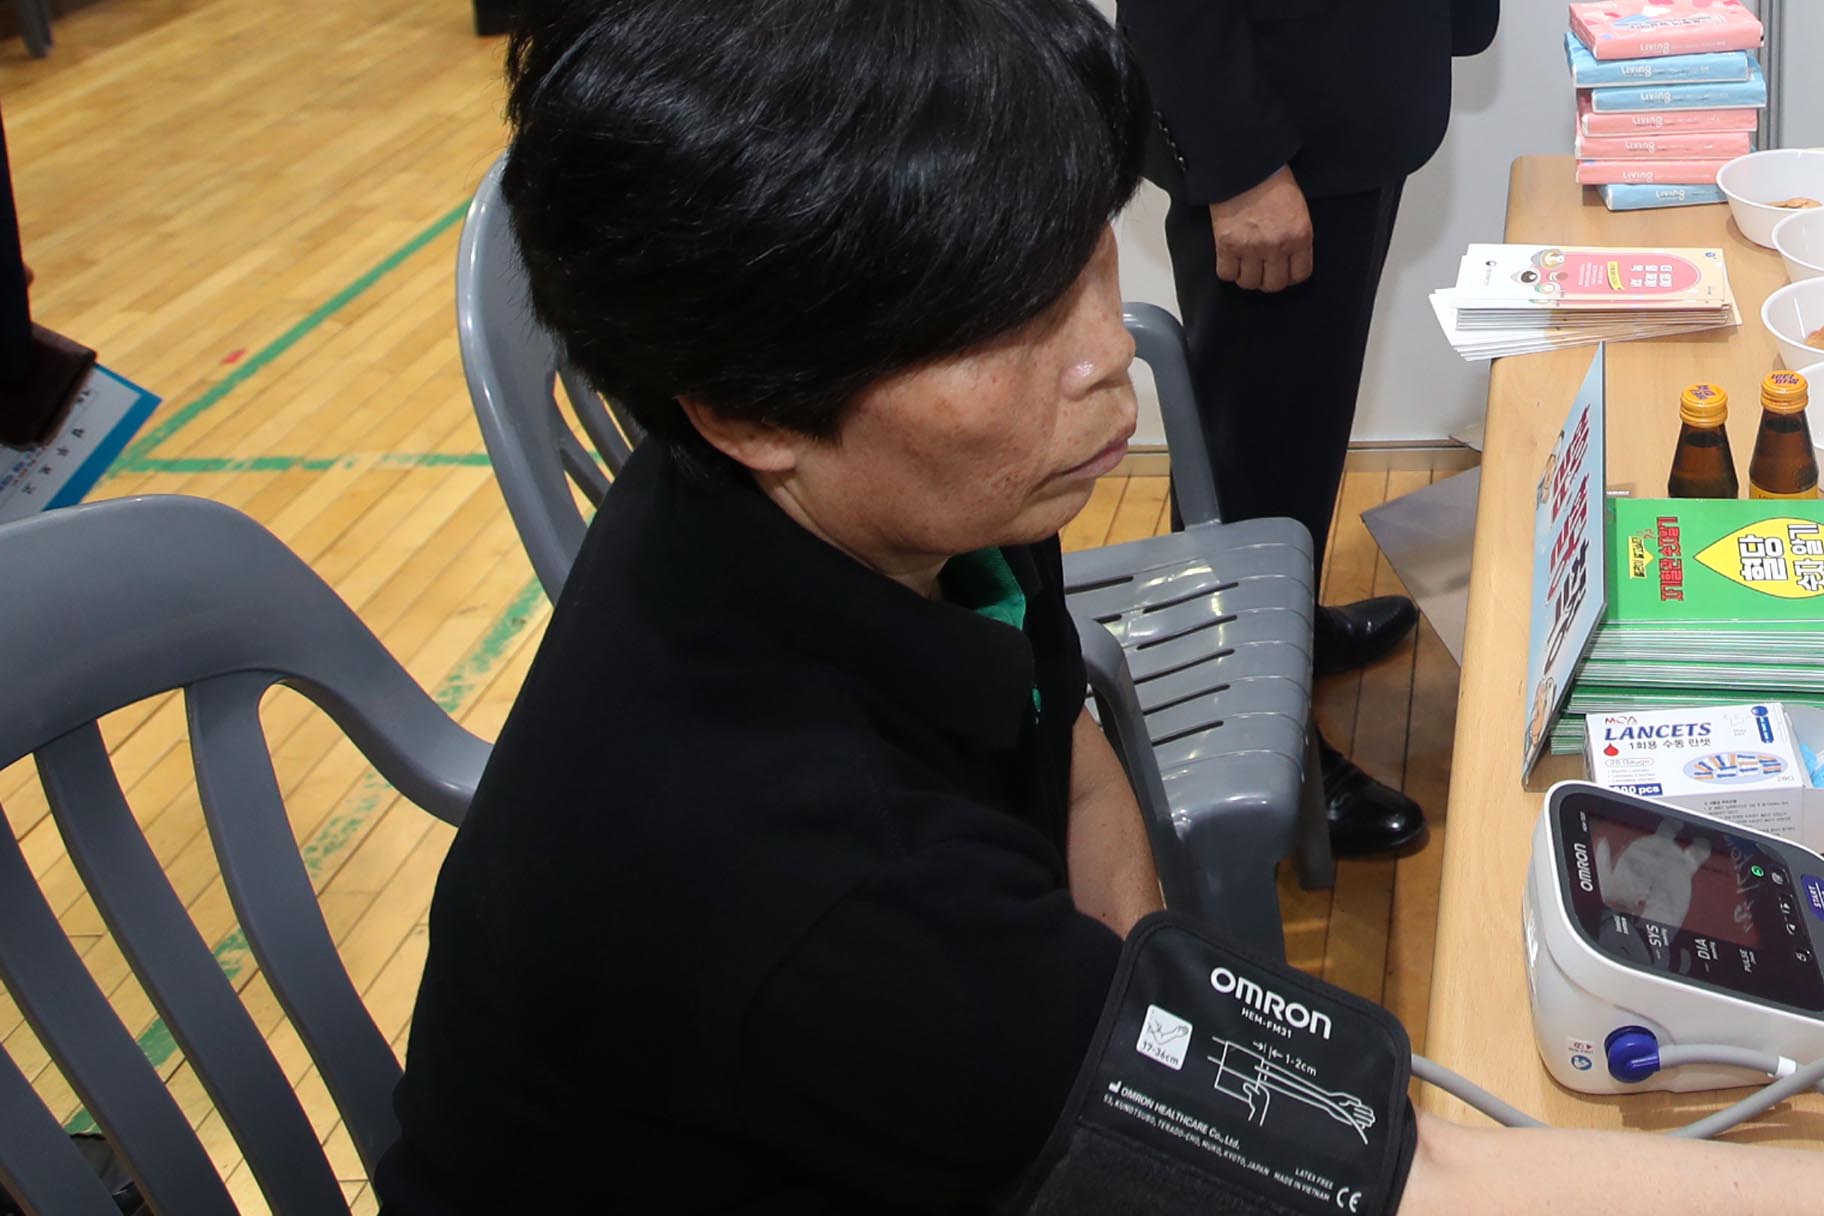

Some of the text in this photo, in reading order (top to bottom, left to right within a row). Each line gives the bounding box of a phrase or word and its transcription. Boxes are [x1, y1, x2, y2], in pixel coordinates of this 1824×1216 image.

[1787, 524, 1824, 556] 알기
[1738, 534, 1788, 582] 혈당
[1604, 722, 1711, 741] LANCETS
[1639, 785, 1660, 796] pcs
[1575, 842, 1594, 892] OMRON
[1808, 885, 1822, 909] START
[1646, 924, 1664, 947] SYS
[1694, 938, 1711, 960] DIA
[1738, 948, 1753, 972] PULSE
[1210, 967, 1331, 1040] OMRON
[1241, 1007, 1293, 1039] HEM-FM31
[1142, 1040, 1180, 1067] 17-36cm
[1285, 1053, 1318, 1077] 1-2cm
[1121, 1086, 1155, 1110] OMRON
[1154, 1102, 1209, 1135] HEALTHCARE
[1225, 1135, 1240, 1150] Ltd.
[1247, 1160, 1270, 1176] JAPAN
[1295, 1167, 1334, 1191] LATEX FREE
[1273, 1171, 1293, 1187] MADE
[1301, 1184, 1331, 1201] VIETNAM
